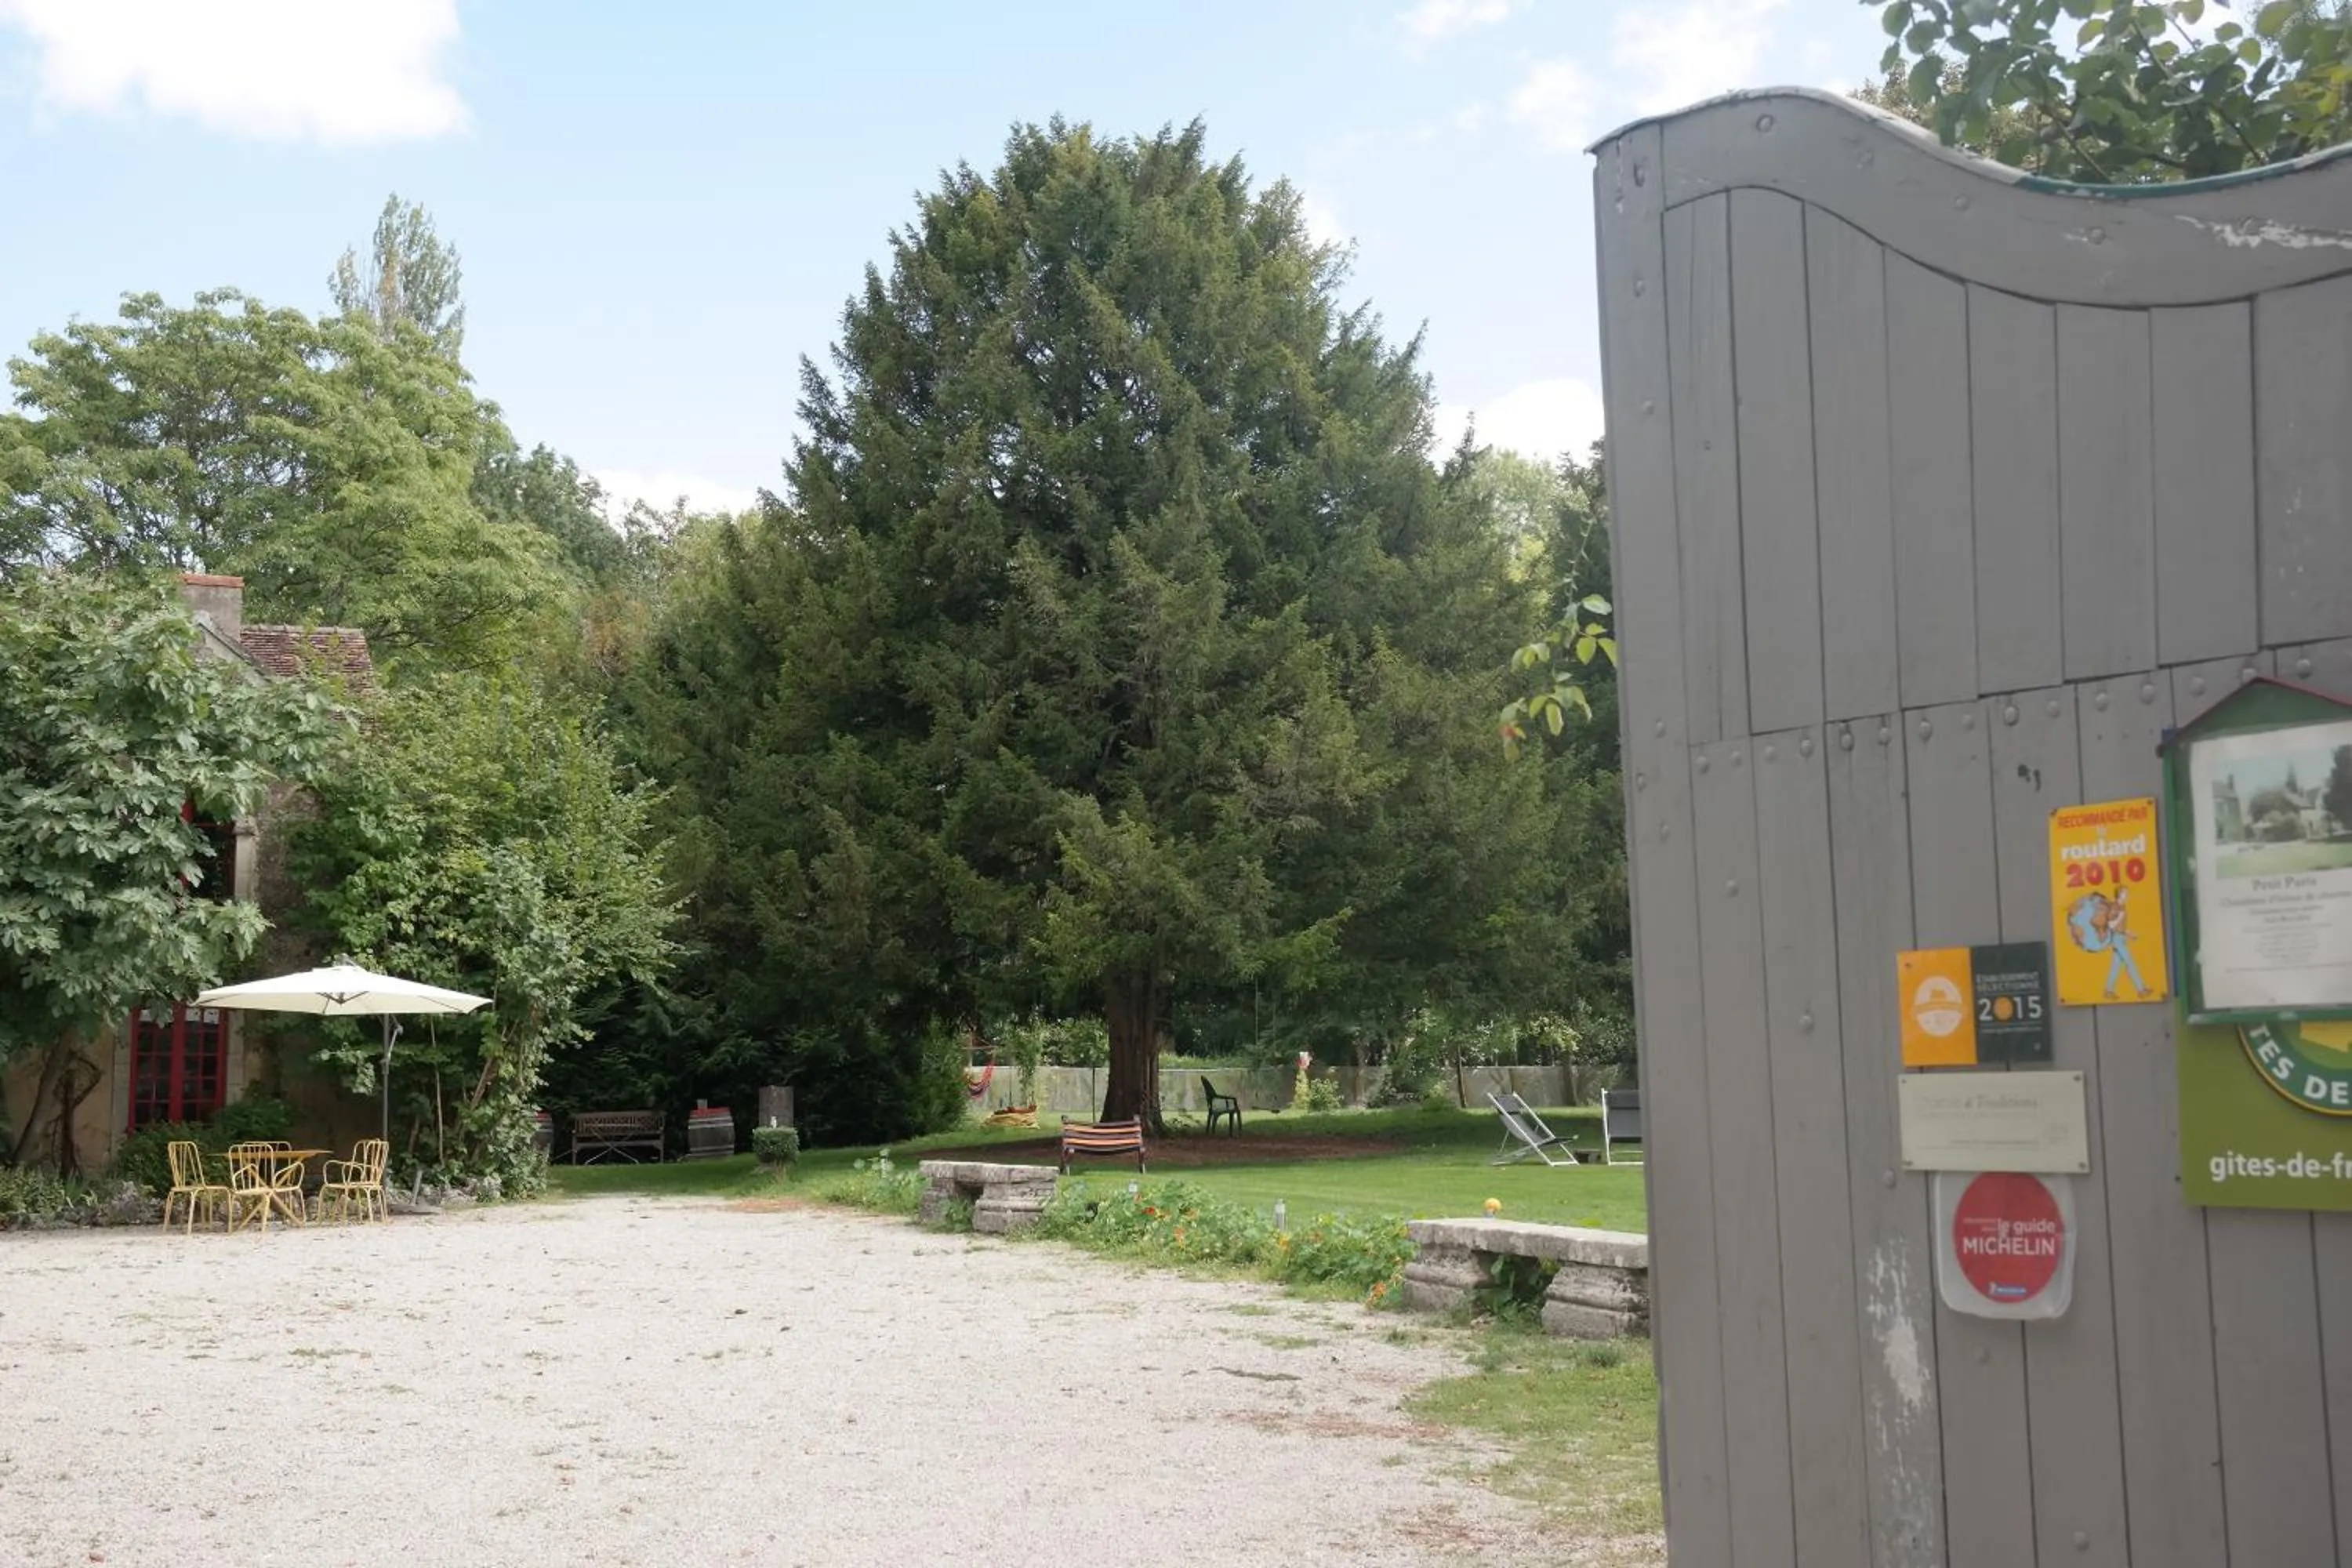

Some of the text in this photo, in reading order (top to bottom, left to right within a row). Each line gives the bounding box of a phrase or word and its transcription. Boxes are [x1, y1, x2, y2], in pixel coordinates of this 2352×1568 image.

[2060, 834, 2146, 860] routard
[2066, 858, 2146, 888] 2010
[2303, 1074, 2349, 1105] DE
[1998, 1218, 2009, 1231] le
[2013, 1217, 2056, 1236] guide
[1962, 1236, 2056, 1255] MICHELIN
